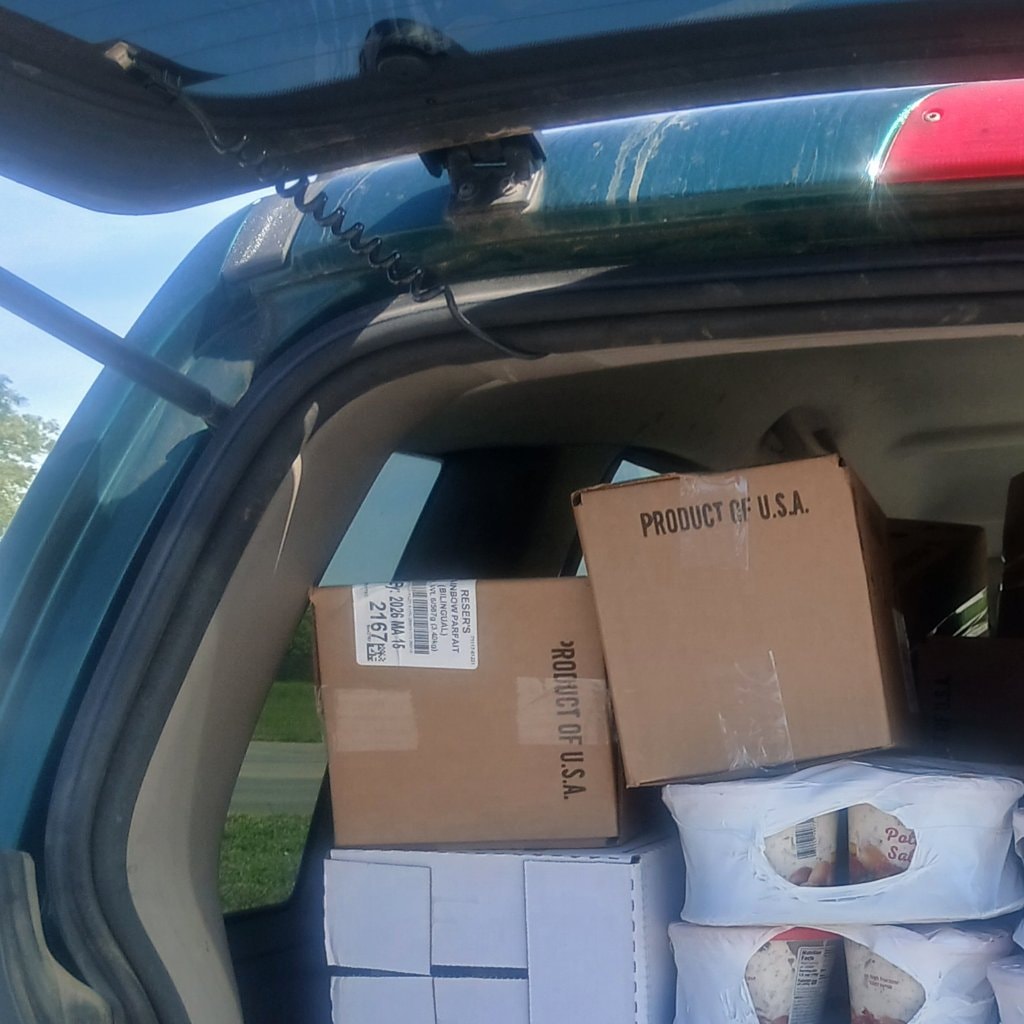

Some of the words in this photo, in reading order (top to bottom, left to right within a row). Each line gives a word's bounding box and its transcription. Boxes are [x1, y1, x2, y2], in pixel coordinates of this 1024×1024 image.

[639, 501, 724, 538] PRODUCT
[729, 496, 752, 524] OF
[757, 489, 810, 521] U.S.A.
[389, 596, 405, 619] 2026
[438, 584, 449, 637] (BILINGUAL)
[450, 580, 460, 614] INBOW
[460, 589, 471, 634] RESER'S
[369, 601, 389, 643] 2167
[391, 620, 406, 635] MA
[451, 614, 460, 653] PARFAIT
[558, 723, 583, 745] OF
[560, 751, 587, 800] U.S.A.
